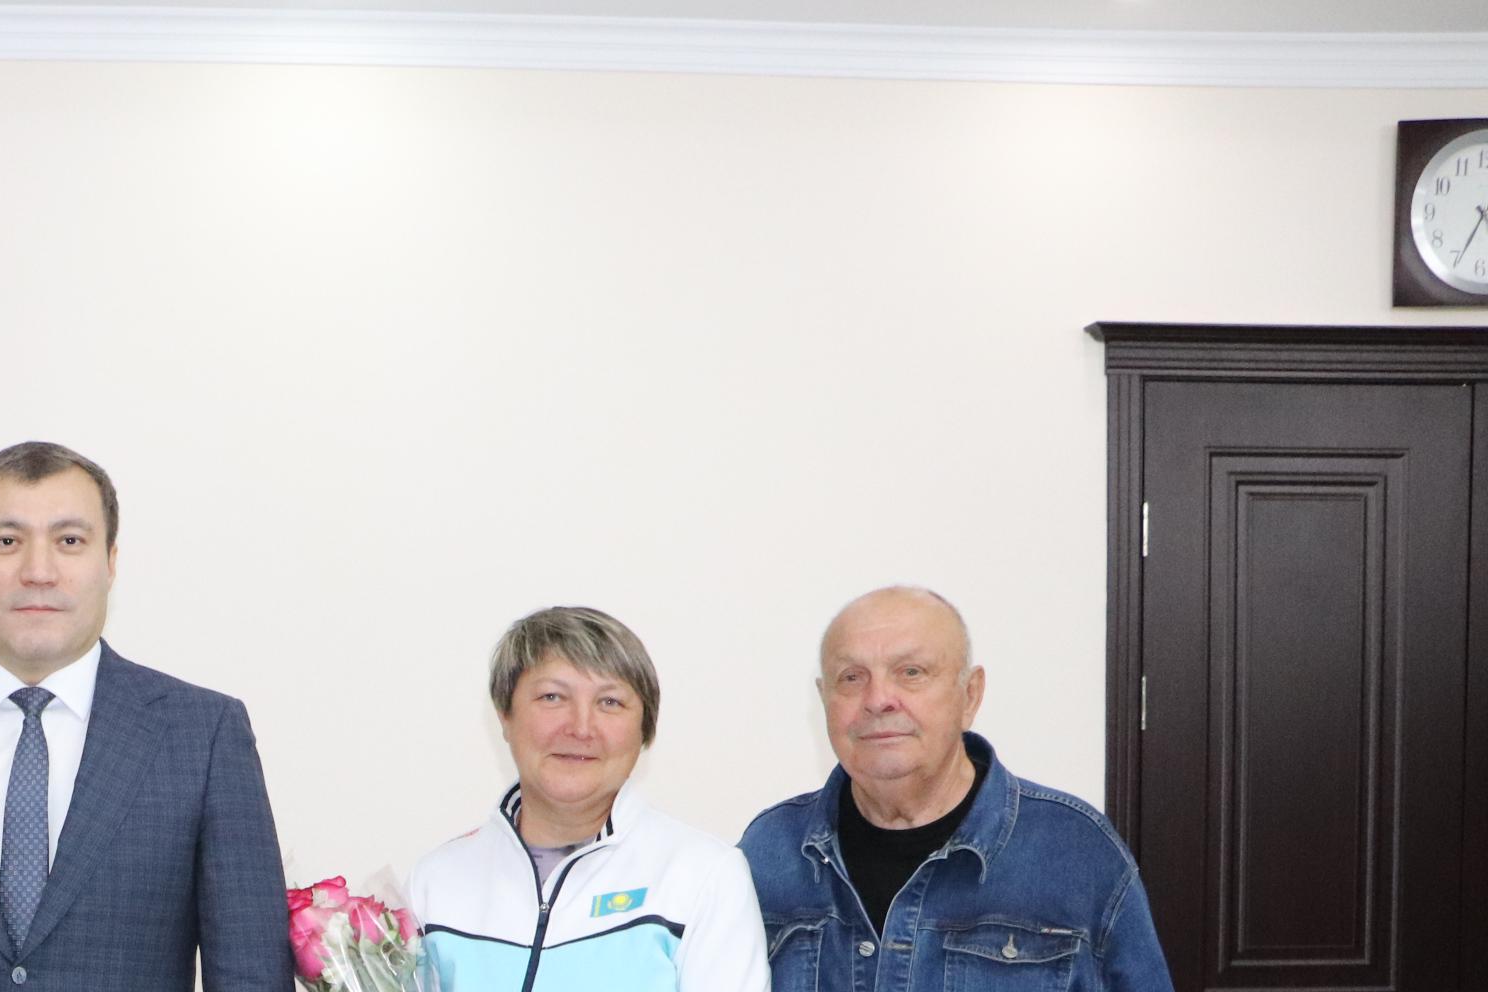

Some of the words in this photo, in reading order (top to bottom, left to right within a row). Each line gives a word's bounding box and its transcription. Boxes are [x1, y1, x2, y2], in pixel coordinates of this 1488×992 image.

[1455, 157, 1469, 177] 11
[1435, 176, 1451, 196] 10
[1424, 203, 1436, 221] 9
[1431, 229, 1444, 248] 8
[1449, 250, 1461, 269] 7
[1474, 259, 1487, 277] 6
